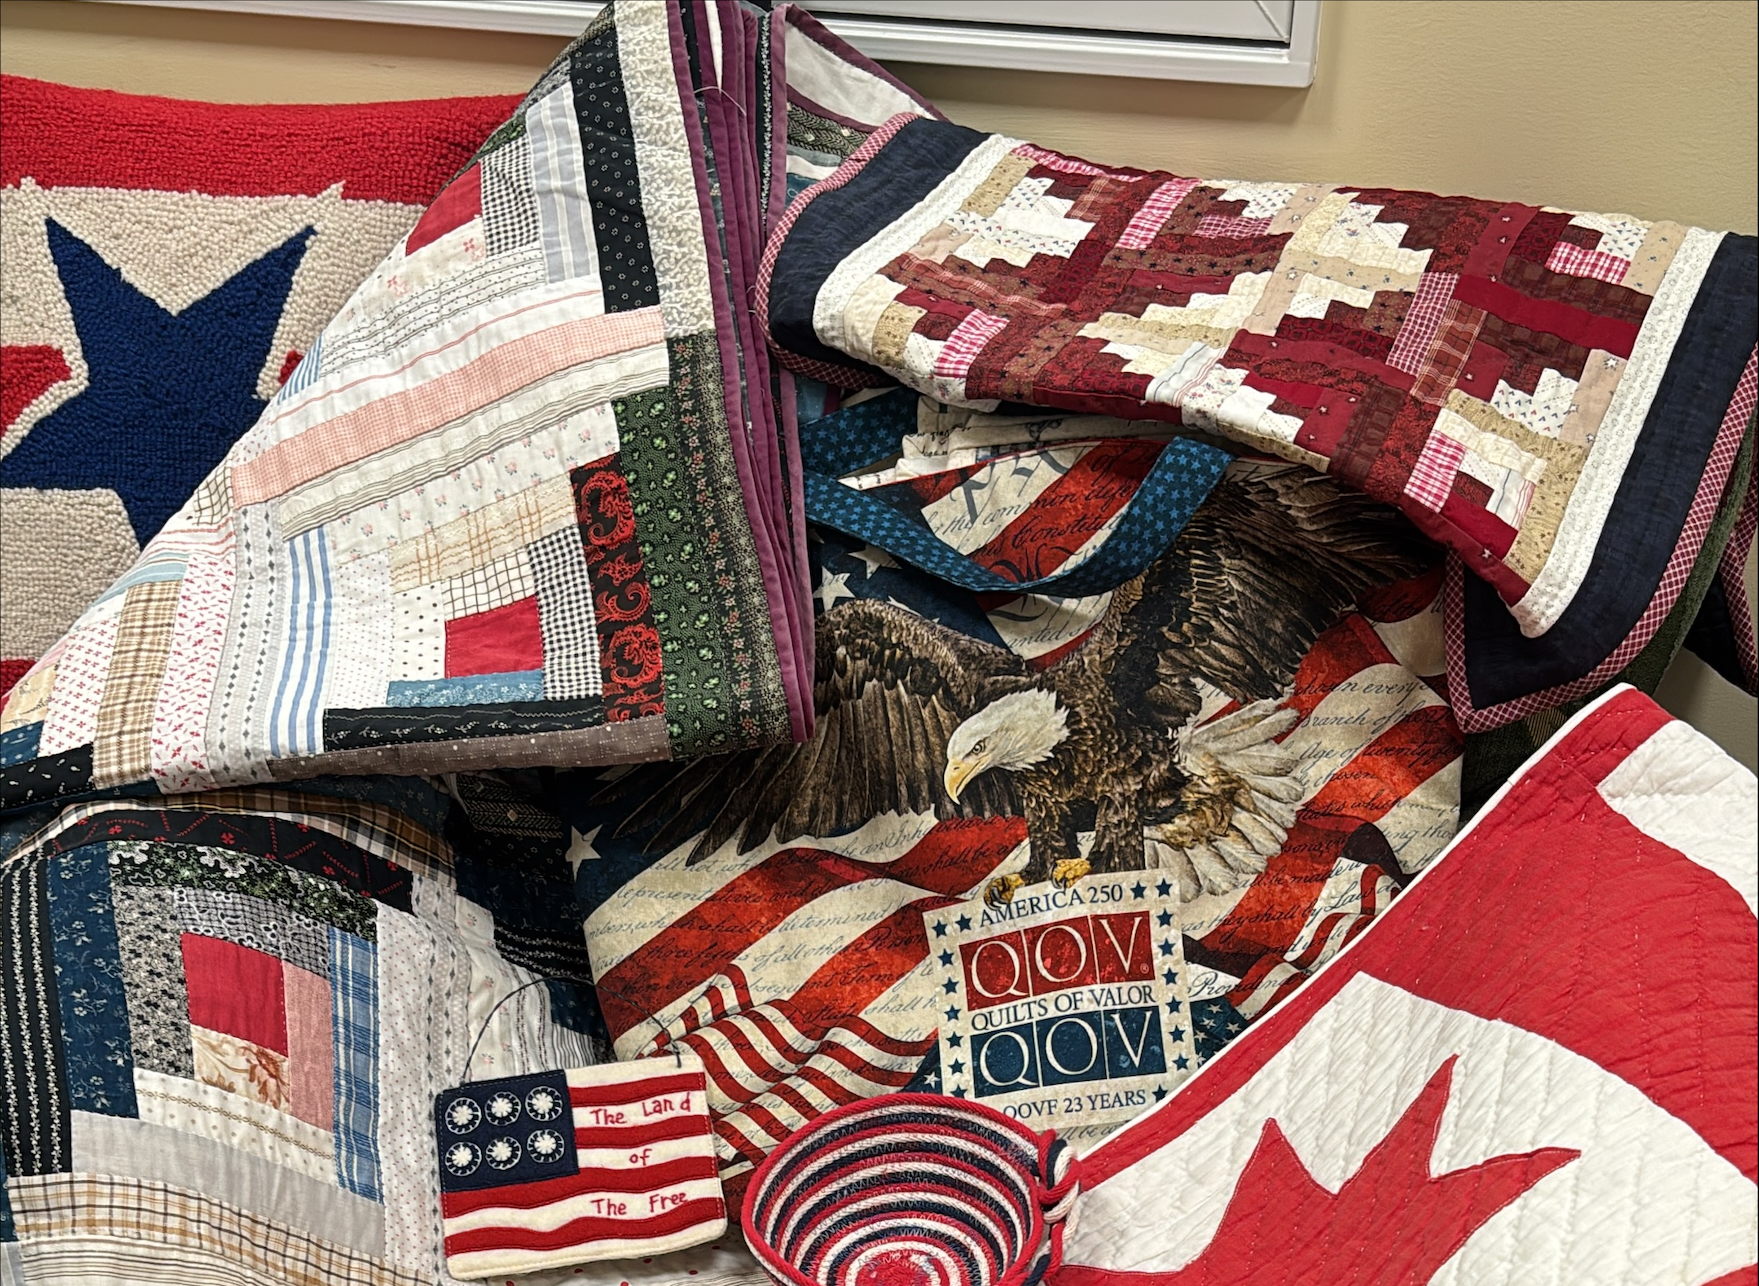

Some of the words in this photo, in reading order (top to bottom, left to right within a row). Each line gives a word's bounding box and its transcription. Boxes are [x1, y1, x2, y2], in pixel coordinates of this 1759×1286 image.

[1011, 513, 1121, 550] Constitut
[979, 889, 1084, 929] AMERICA
[1088, 884, 1123, 902] 250
[971, 916, 1143, 998] QOV
[971, 997, 1048, 1032] QUILTS
[1054, 991, 1084, 1013] OF
[1088, 985, 1156, 1011] VALOR
[979, 1010, 1153, 1087] QOV
[590, 1108, 626, 1125] The
[642, 1091, 691, 1116] Land
[1063, 1096, 1084, 1114] 23
[1086, 1089, 1147, 1110] YEARS
[629, 1148, 653, 1166] of
[590, 1198, 627, 1216] The
[649, 1191, 688, 1213] Free
